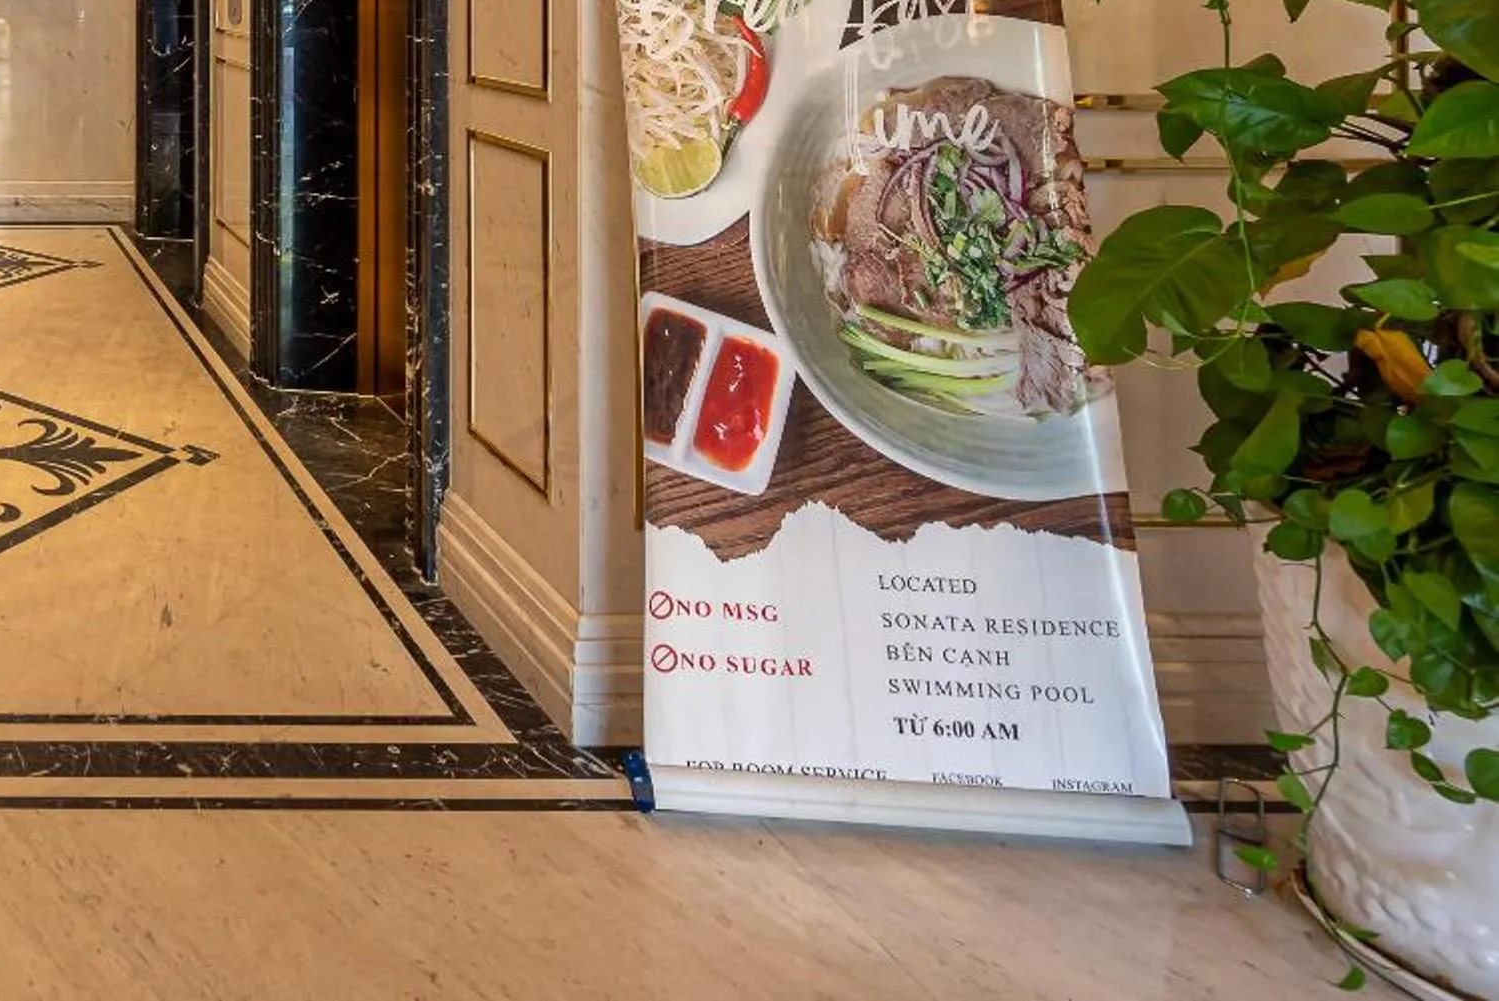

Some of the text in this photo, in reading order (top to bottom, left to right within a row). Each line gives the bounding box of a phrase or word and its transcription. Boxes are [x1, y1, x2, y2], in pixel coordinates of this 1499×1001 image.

[878, 574, 978, 595] LOCATED
[676, 600, 779, 622] NO MSG
[880, 613, 1121, 638] SONATA RESIDENCE
[680, 653, 814, 677] NO SUGAR
[942, 648, 1011, 668] CẠNH
[888, 678, 1095, 704] SWIMMING POOL
[893, 713, 1020, 741] TỪ 6:00 AM
[931, 772, 1134, 794] FACEBOOK INSTAGRAM
